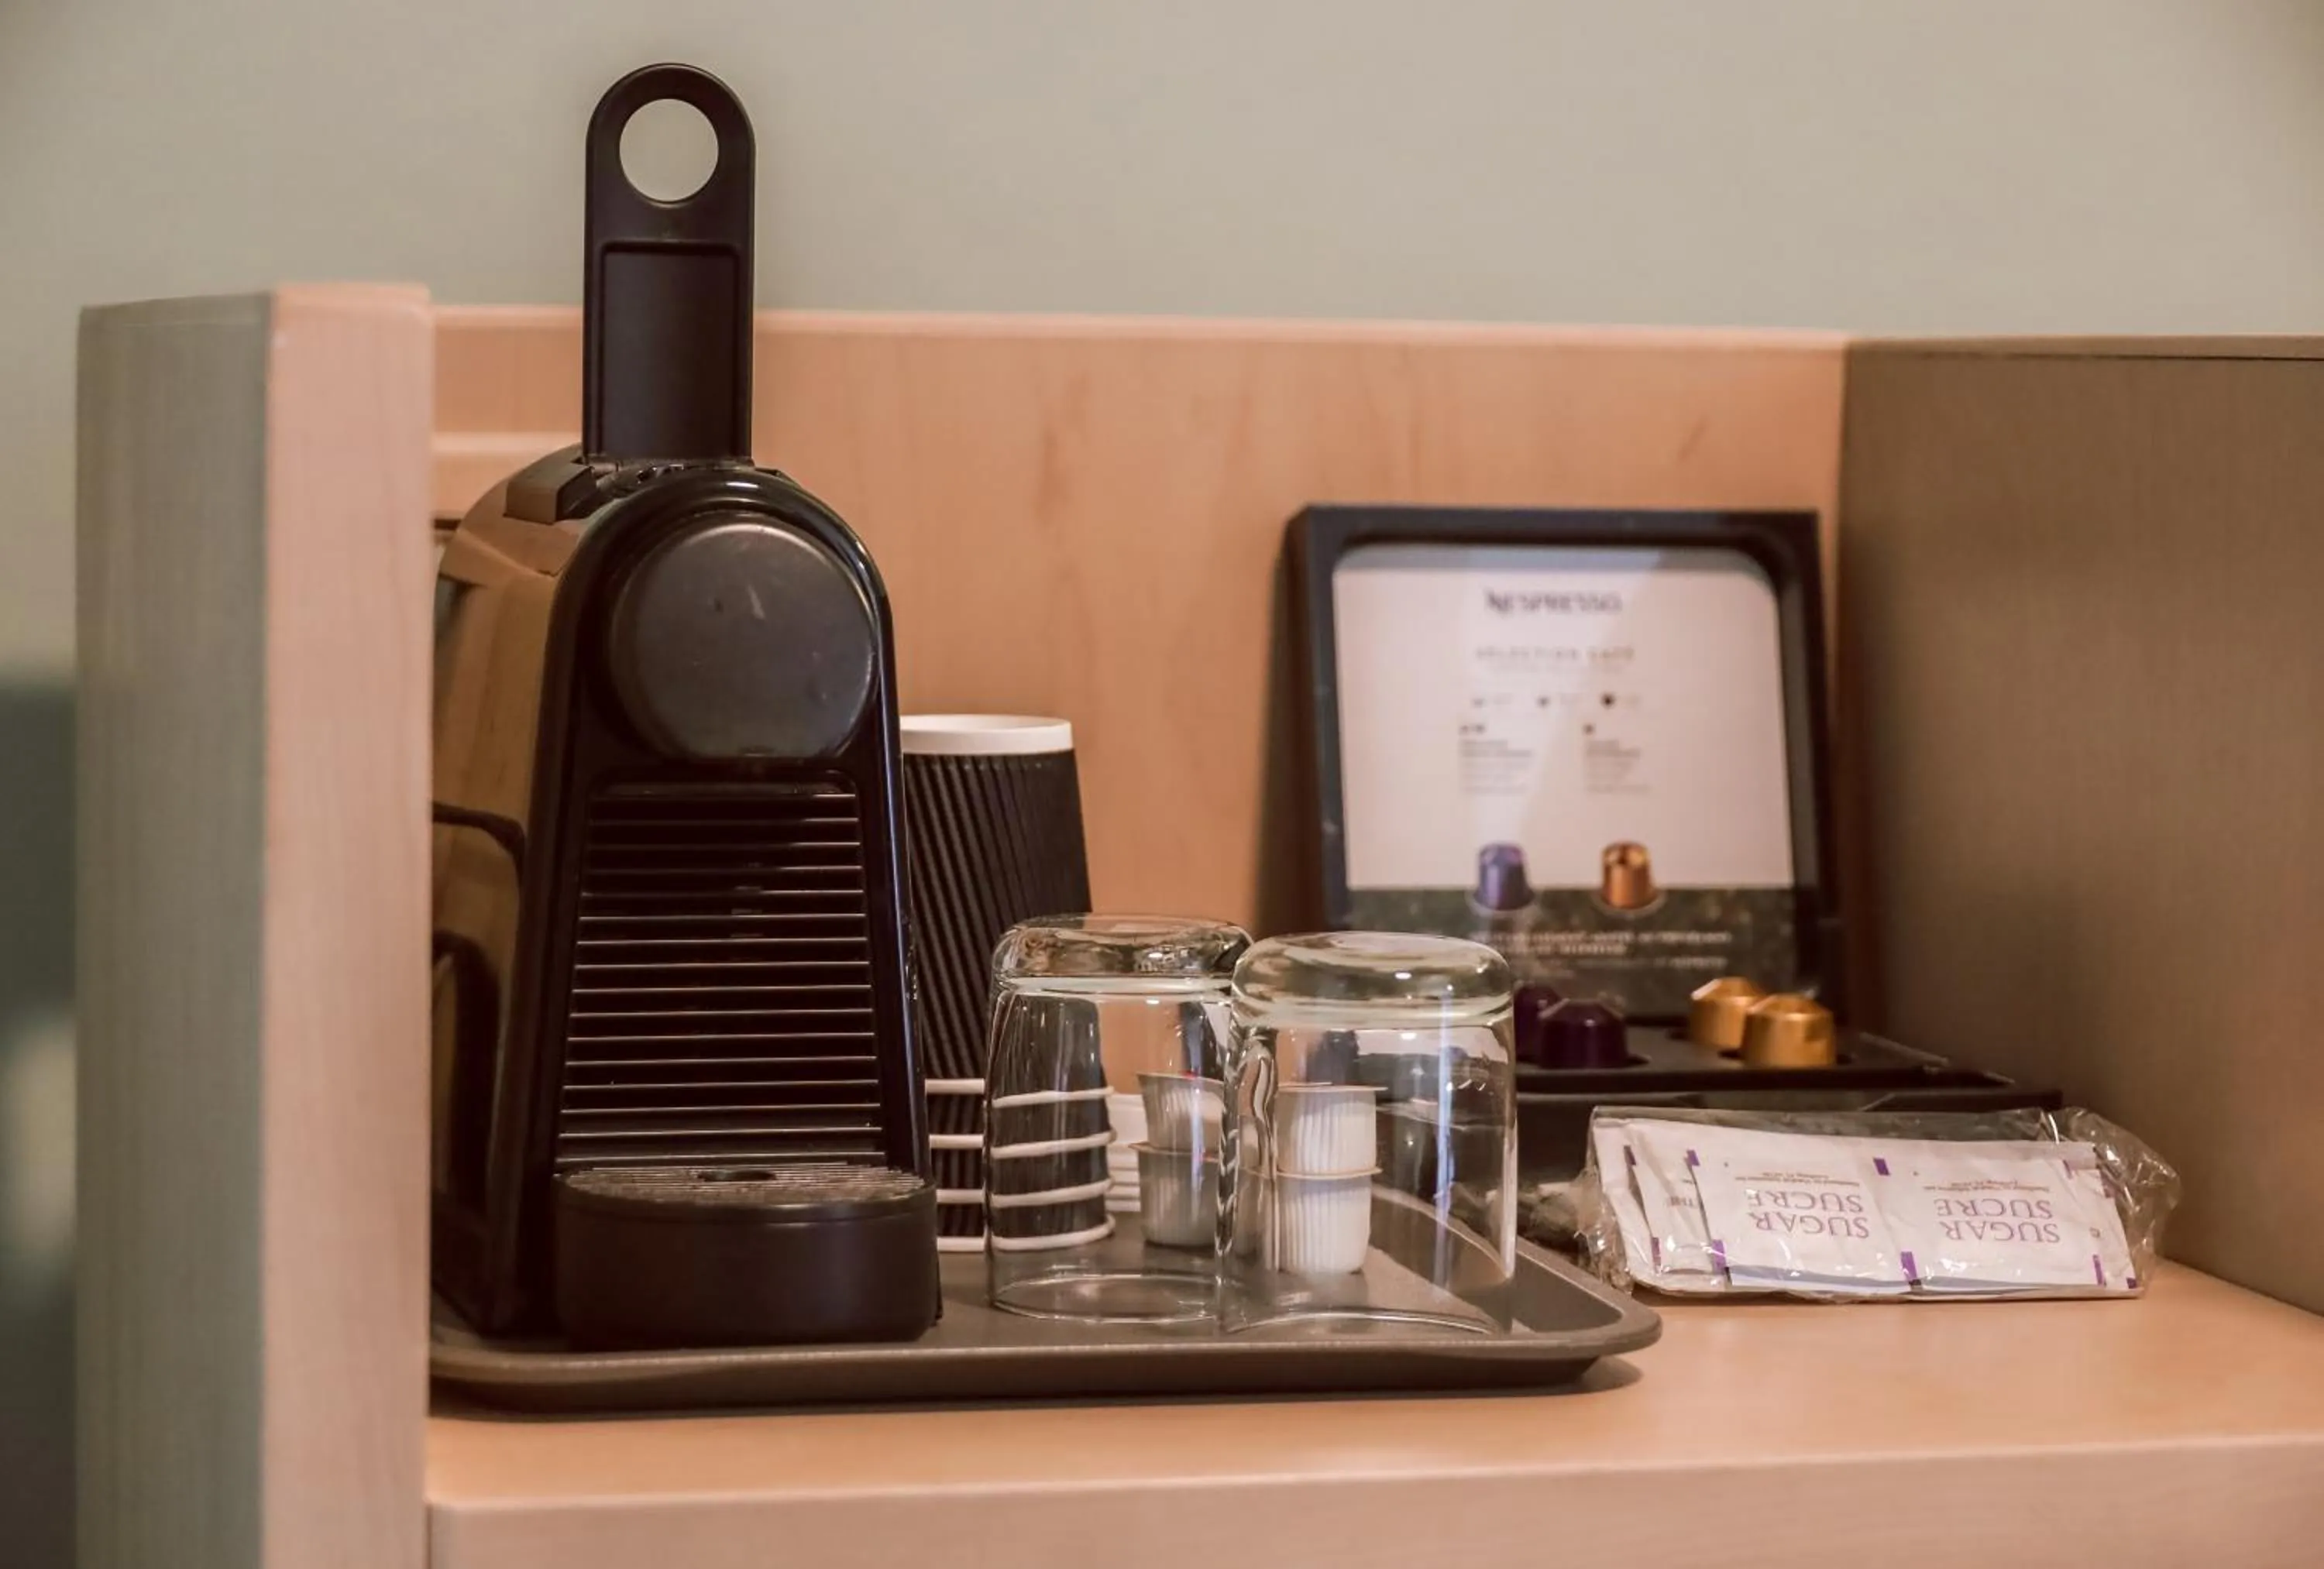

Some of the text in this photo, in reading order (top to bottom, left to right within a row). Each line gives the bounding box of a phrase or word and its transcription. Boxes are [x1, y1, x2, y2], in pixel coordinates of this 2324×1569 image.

[1483, 589, 1623, 615] NESPRESSO
[1746, 1190, 1863, 1212] SUCRE
[1934, 1198, 2053, 1219] SUCRE
[1747, 1211, 1868, 1238] SUGAR
[1939, 1221, 2060, 1243] SUGAR
